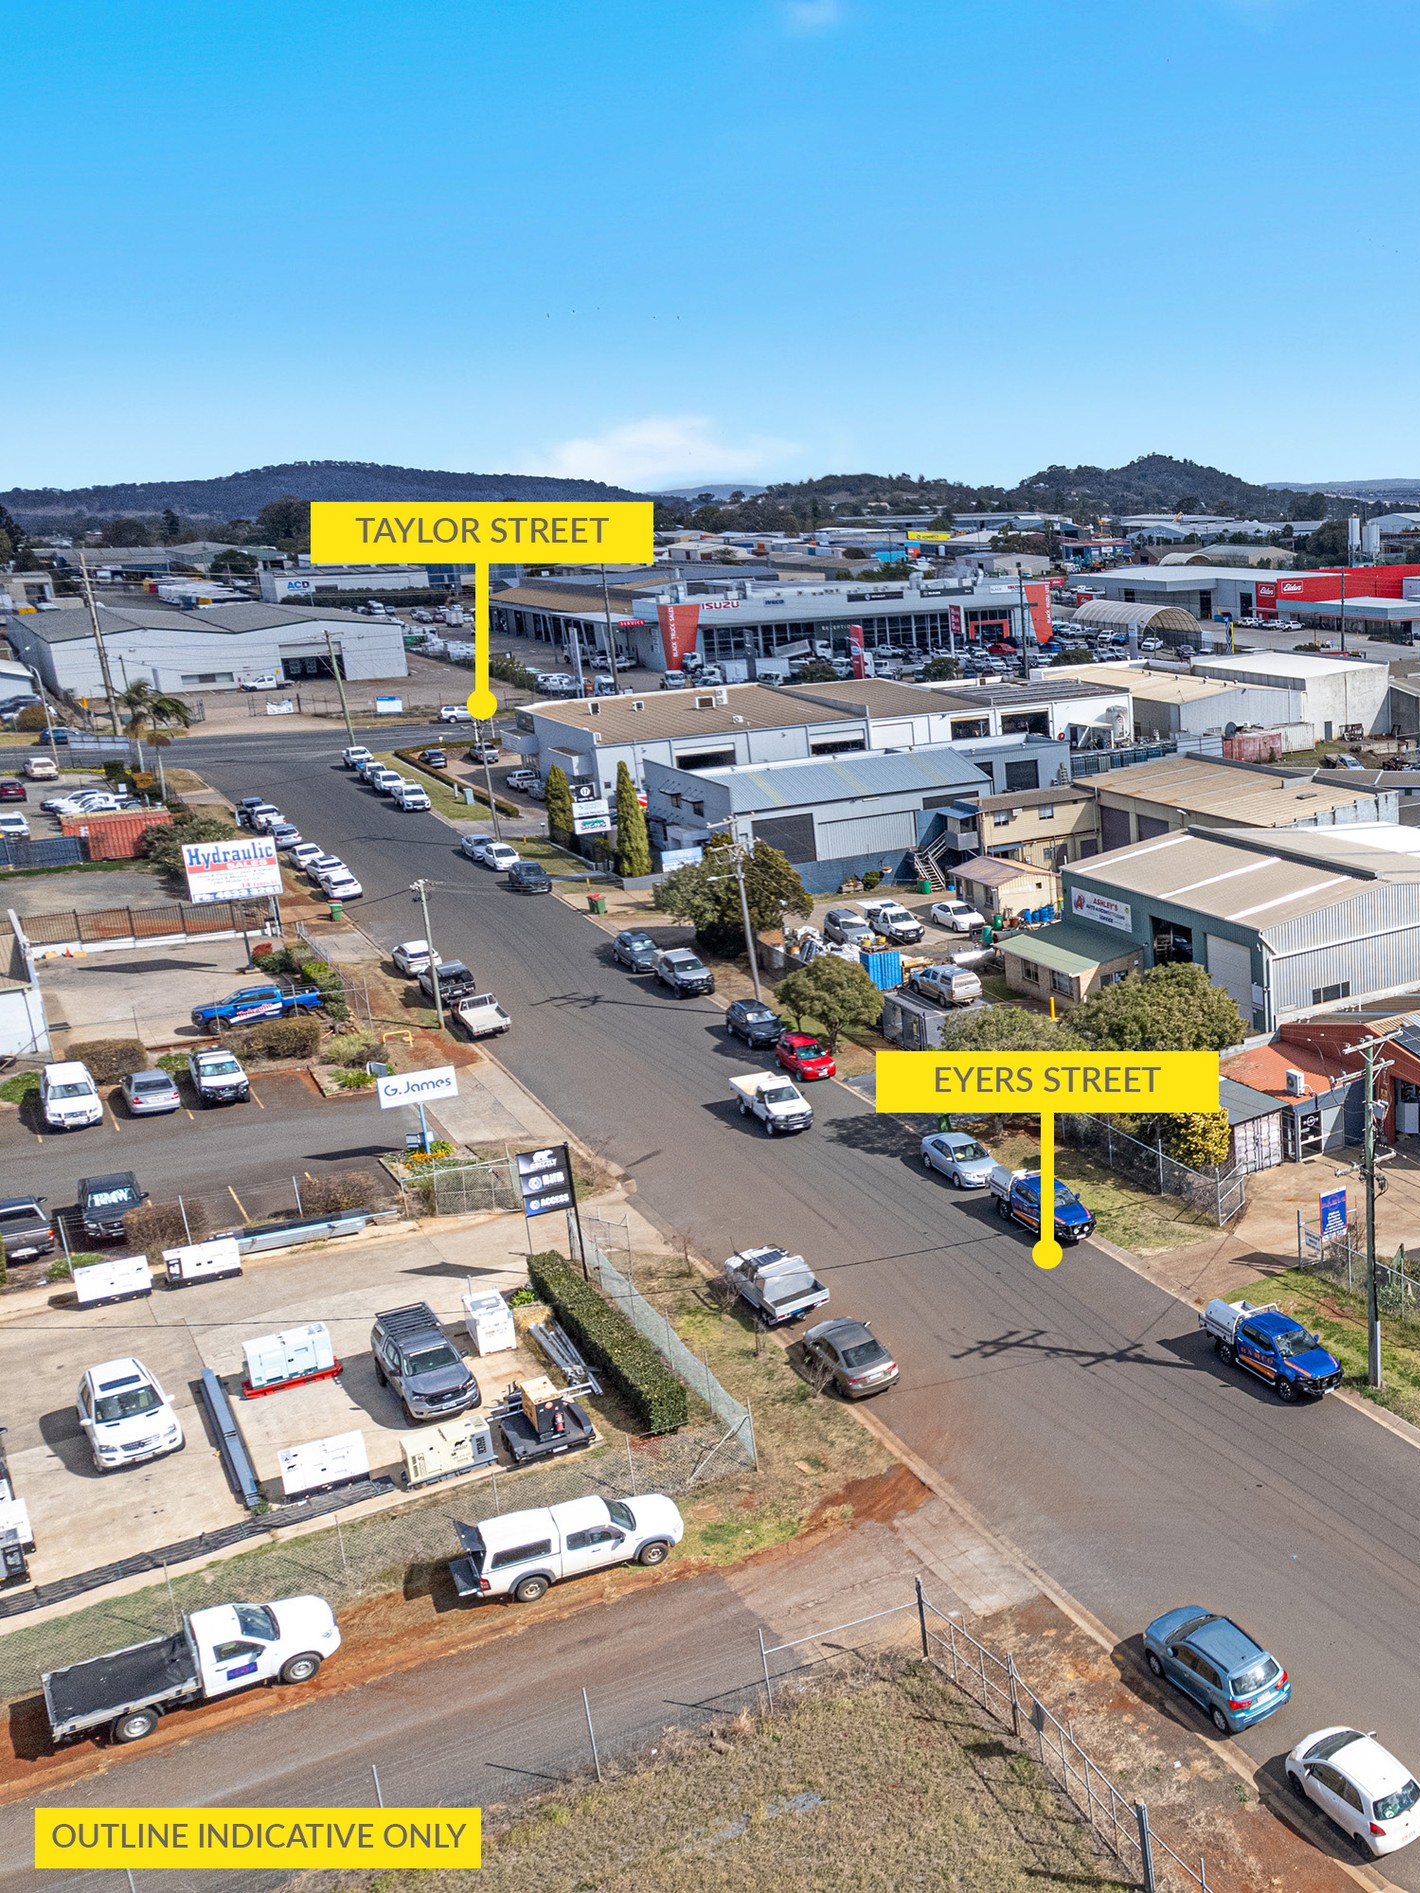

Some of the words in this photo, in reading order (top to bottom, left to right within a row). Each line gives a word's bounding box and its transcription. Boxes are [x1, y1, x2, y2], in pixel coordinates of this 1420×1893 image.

[287, 580, 310, 590] ACD
[702, 601, 740, 610] ISUZU
[186, 842, 273, 869] Hydraulic
[226, 859, 268, 870] SALES
[384, 1077, 452, 1097] G.James
